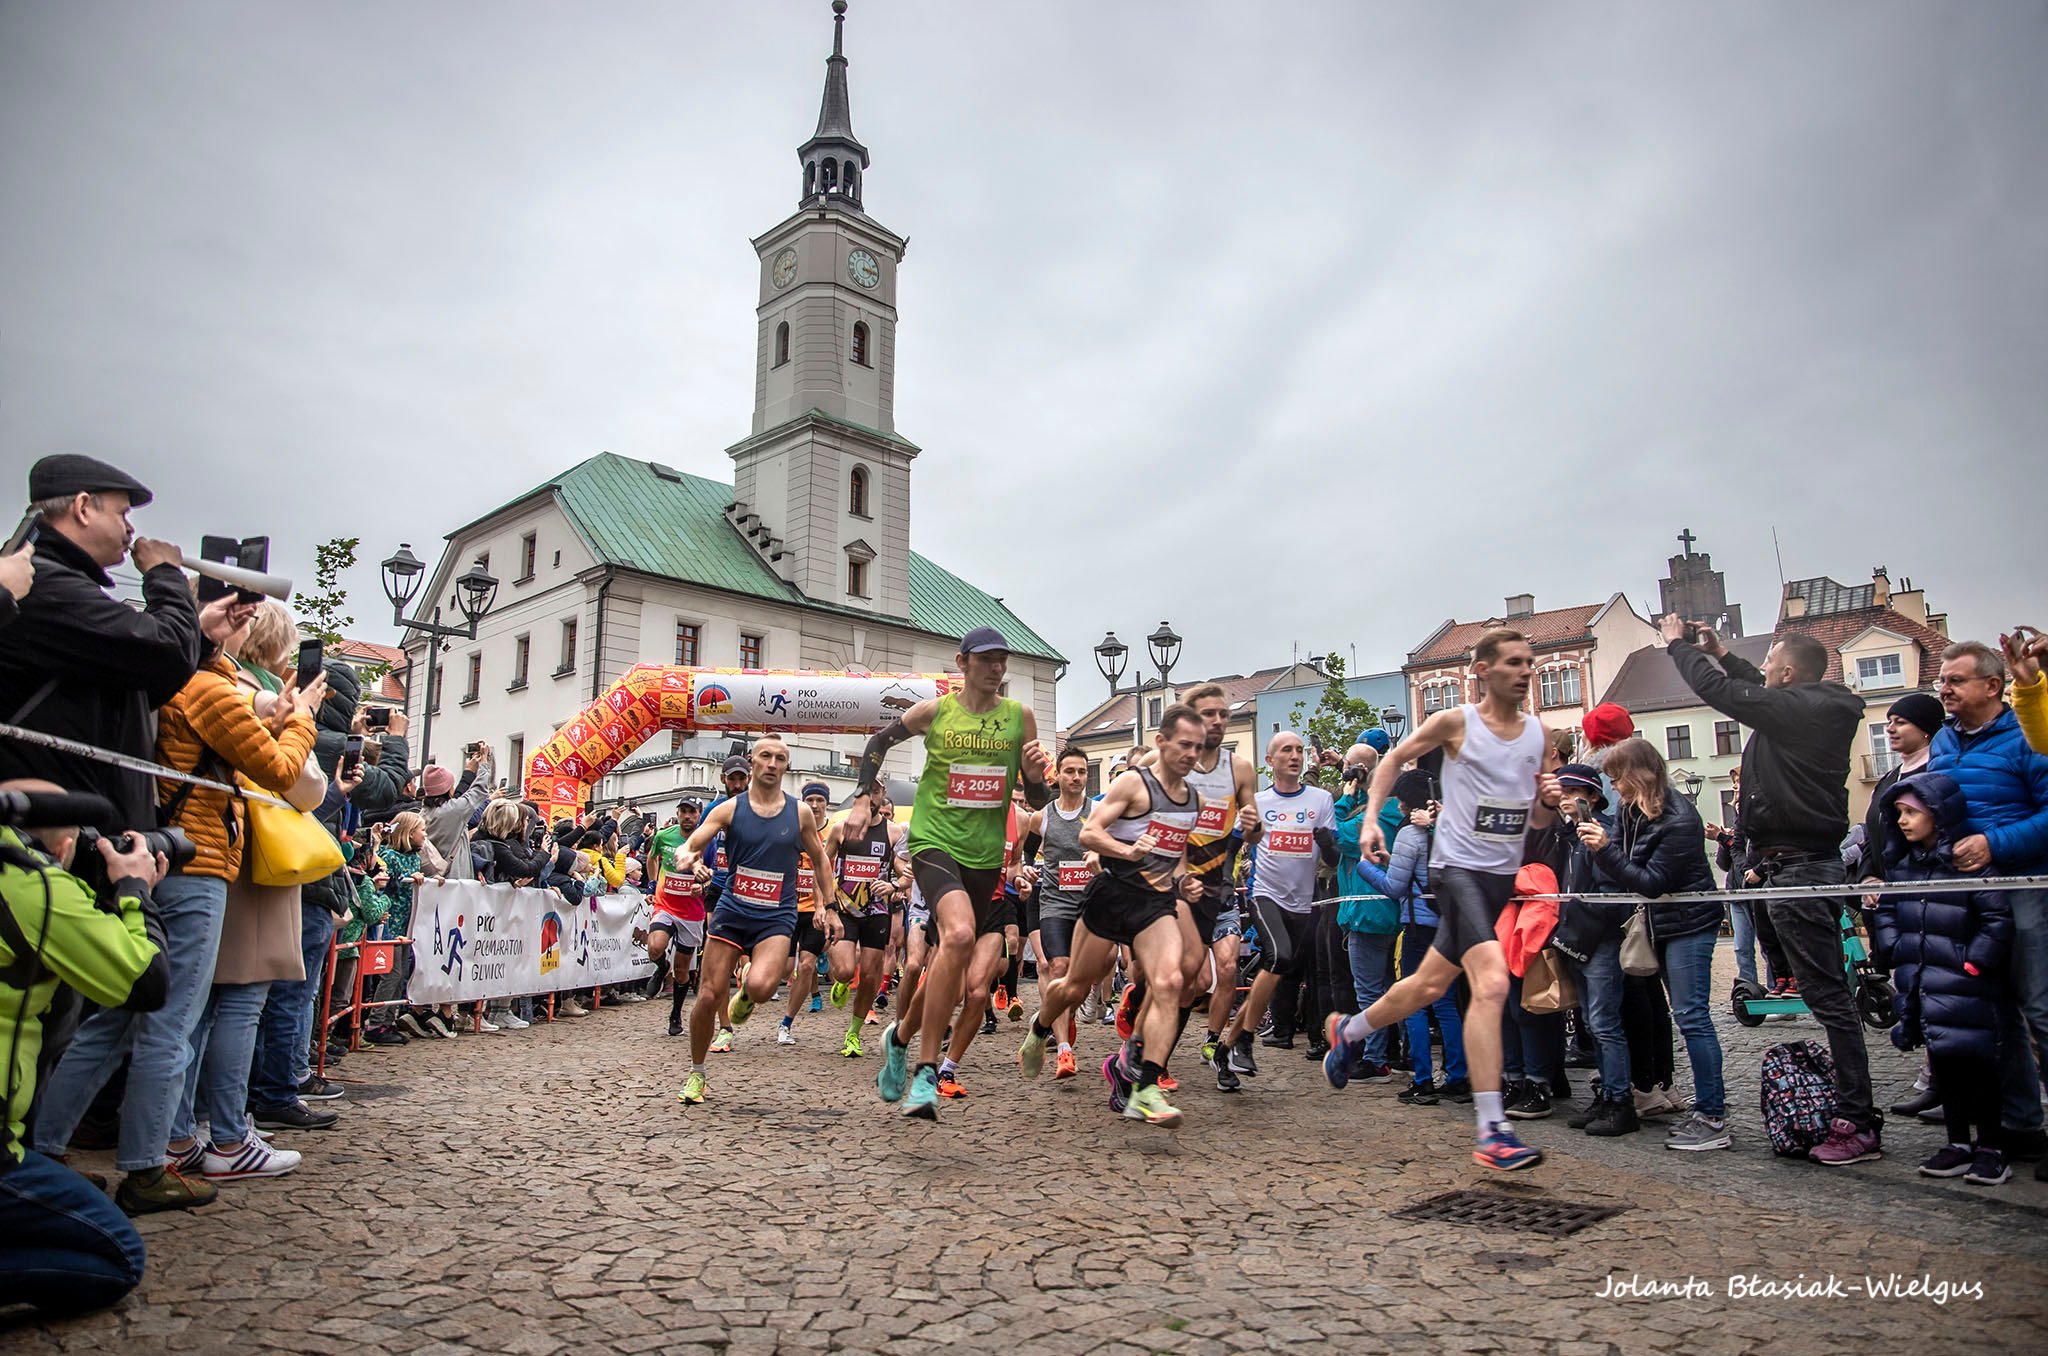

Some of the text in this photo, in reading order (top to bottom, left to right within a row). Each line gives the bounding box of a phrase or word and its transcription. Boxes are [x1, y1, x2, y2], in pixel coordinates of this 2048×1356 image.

[797, 689, 818, 698] PKO
[797, 699, 860, 710] PÓŁMARATON
[797, 711, 838, 720] GLIWICKI
[968, 779, 1000, 791] 2054
[1198, 809, 1222, 822] 684
[1284, 835, 1309, 845] 2118
[856, 864, 876, 873] 2849
[1073, 870, 1094, 879] 269
[674, 879, 690, 888] 2251
[750, 881, 777, 893] 2457
[477, 915, 496, 932] PKO
